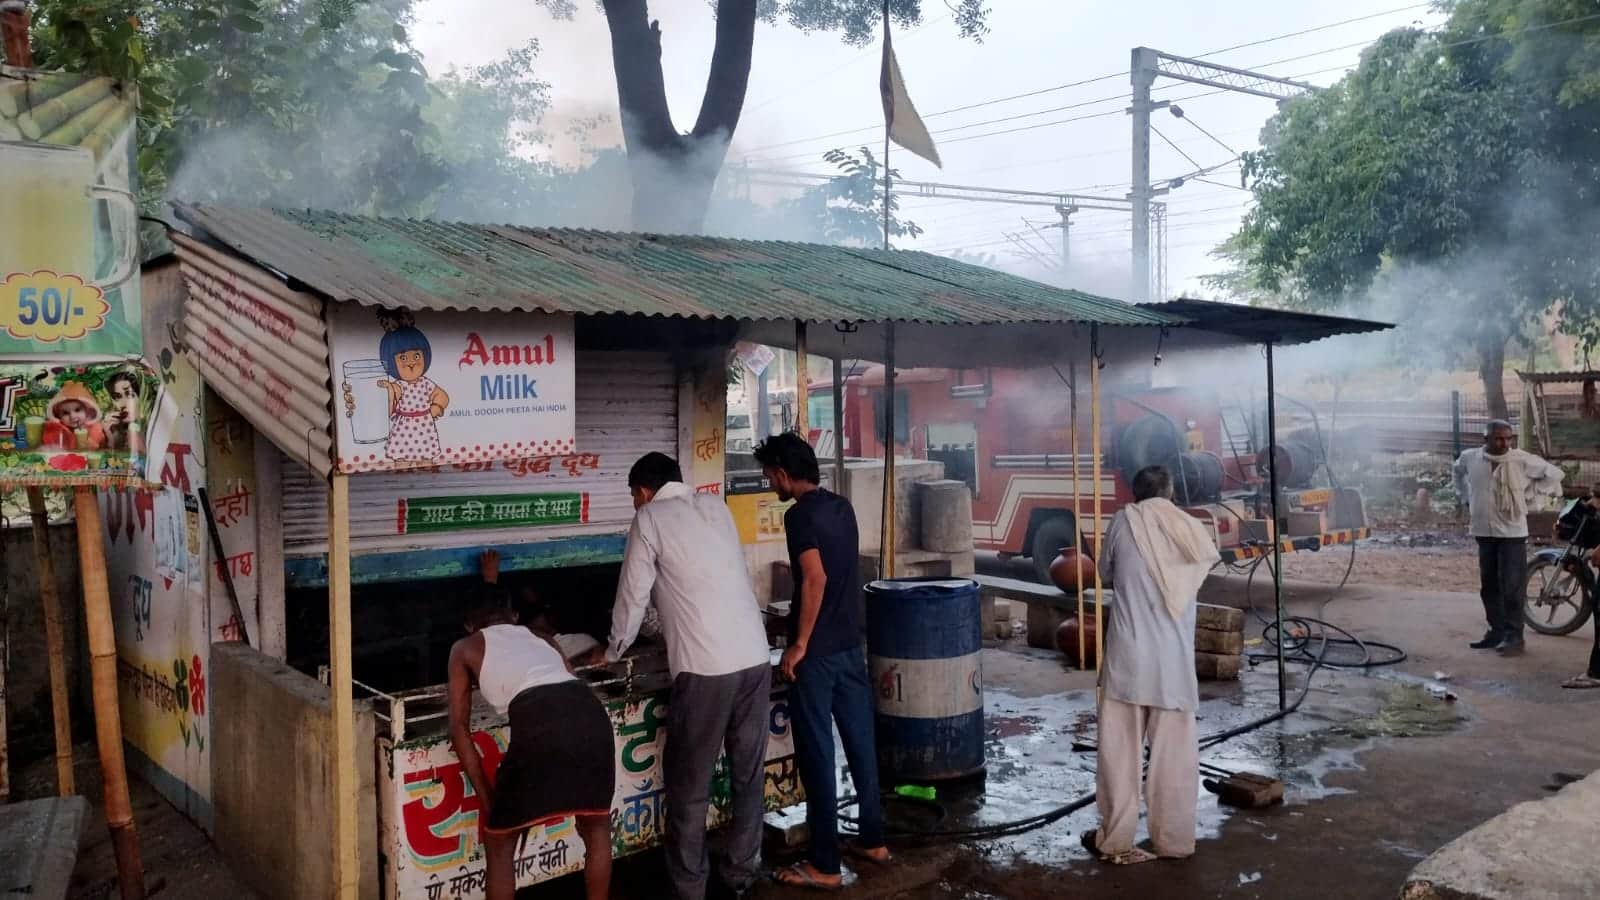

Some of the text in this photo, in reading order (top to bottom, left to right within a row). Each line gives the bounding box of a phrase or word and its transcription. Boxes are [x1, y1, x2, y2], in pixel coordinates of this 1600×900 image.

[18, 287, 84, 326] 50/-
[459, 332, 556, 371] Amul
[480, 374, 538, 401] Milk
[449, 404, 567, 417] AMUL DOODH PEETA HAI INDIA
[421, 505, 457, 523] गाय
[460, 500, 485, 521] की
[493, 502, 530, 519] ममता
[534, 497, 547, 518] से
